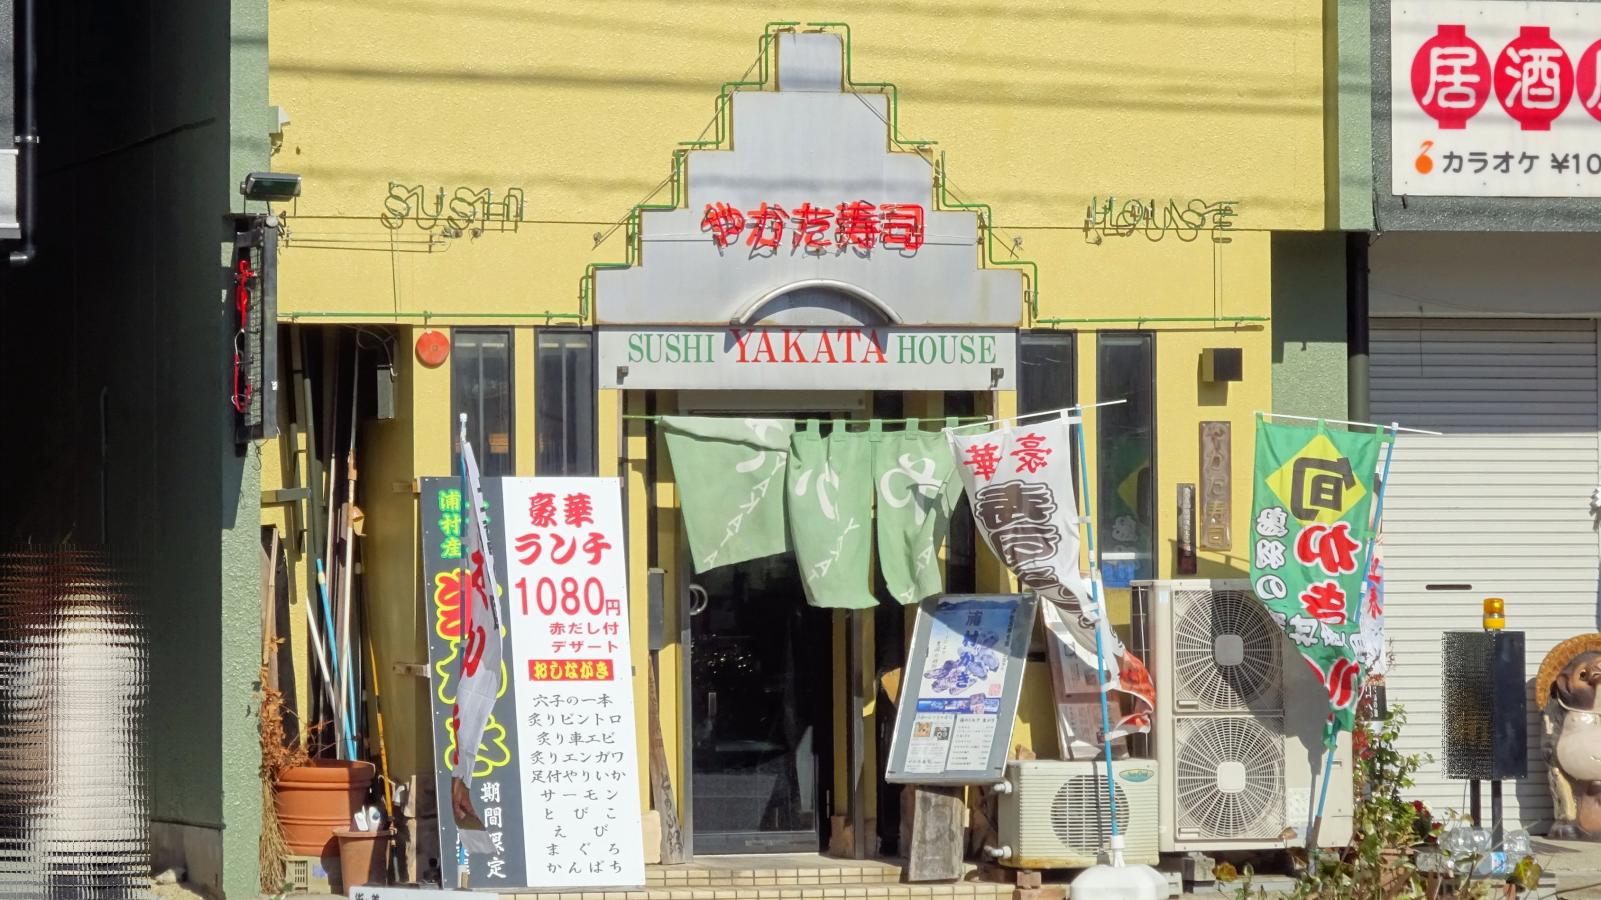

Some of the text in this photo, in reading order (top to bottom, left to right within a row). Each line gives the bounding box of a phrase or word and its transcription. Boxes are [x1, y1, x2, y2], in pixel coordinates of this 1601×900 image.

[1421, 46, 1601, 110] 居酒
[1442, 150, 1540, 174] カラオケ
[383, 182, 525, 230] SUSHI
[700, 201, 924, 253] やかた寿司
[627, 328, 997, 364] SUSHI YAKATA HOUSE
[528, 492, 594, 528] 豪華
[515, 532, 612, 566] ランチ
[515, 576, 621, 617] 1080円
[549, 622, 619, 636] 赤だし付
[551, 640, 619, 653] デザート
[534, 661, 610, 681] おしながき
[532, 693, 613, 708] 穴子の一本
[536, 731, 616, 746] 炙り車エビ
[529, 750, 625, 766] 炙りエンガワ
[530, 770, 627, 784] 足付やりいか
[540, 789, 619, 802] サーモン
[546, 842, 620, 856] まぐろ
